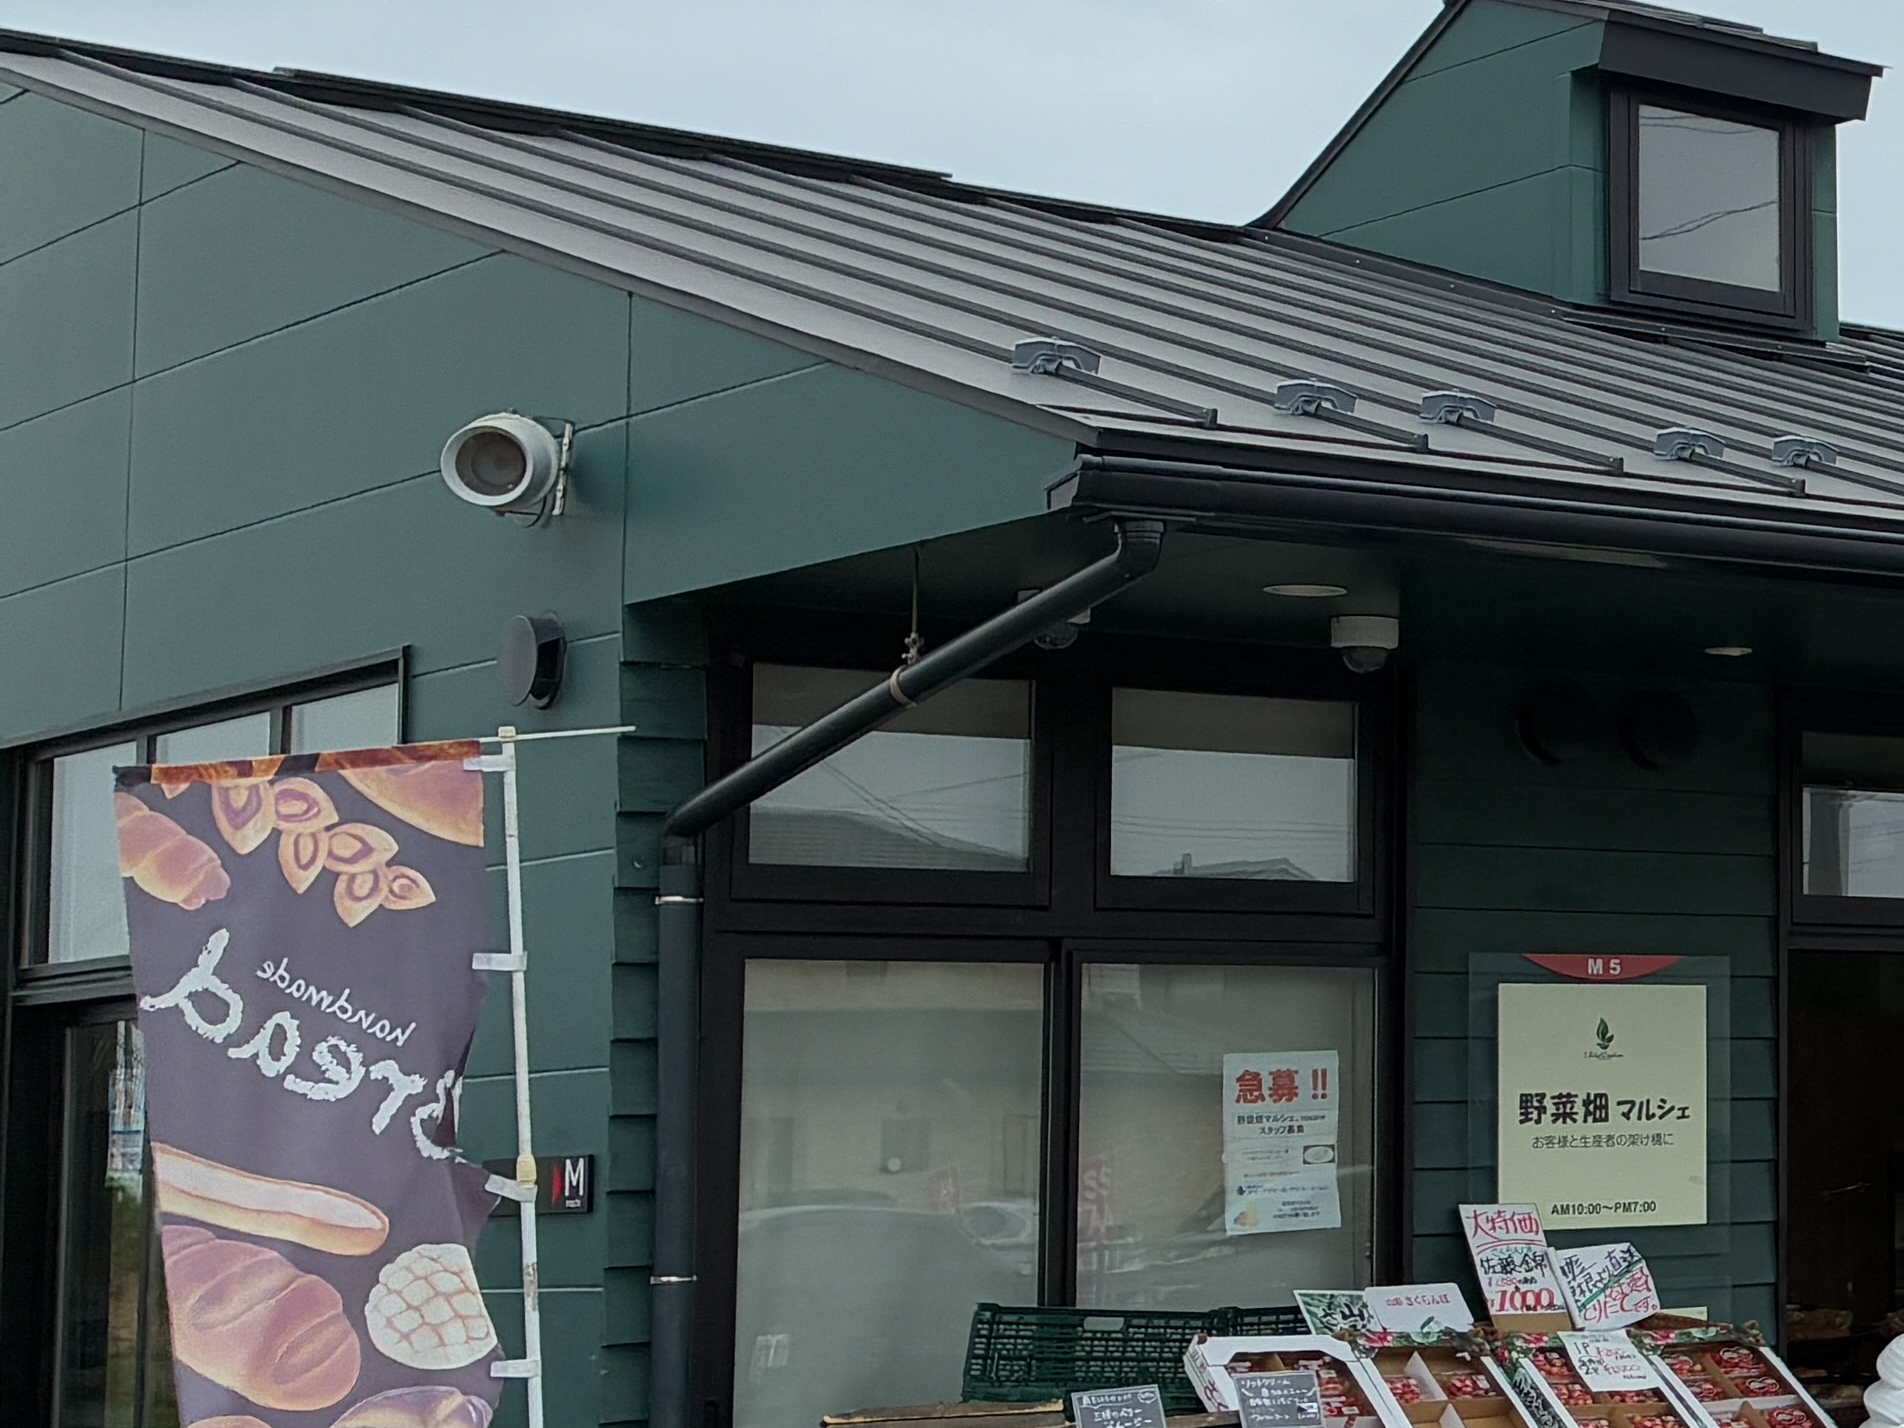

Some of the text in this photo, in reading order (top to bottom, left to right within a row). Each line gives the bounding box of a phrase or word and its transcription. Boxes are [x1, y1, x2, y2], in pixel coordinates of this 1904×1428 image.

[1587, 958, 1622, 975] M 5
[1235, 1067, 1300, 1105] 急募
[1518, 1091, 1691, 1125] 野菜畑 マルシェ
[1532, 1132, 1675, 1150] お客様と生産者の架け橋に
[1466, 1209, 1541, 1240] 大特価
[1479, 1251, 1548, 1278] 佐藤錦
